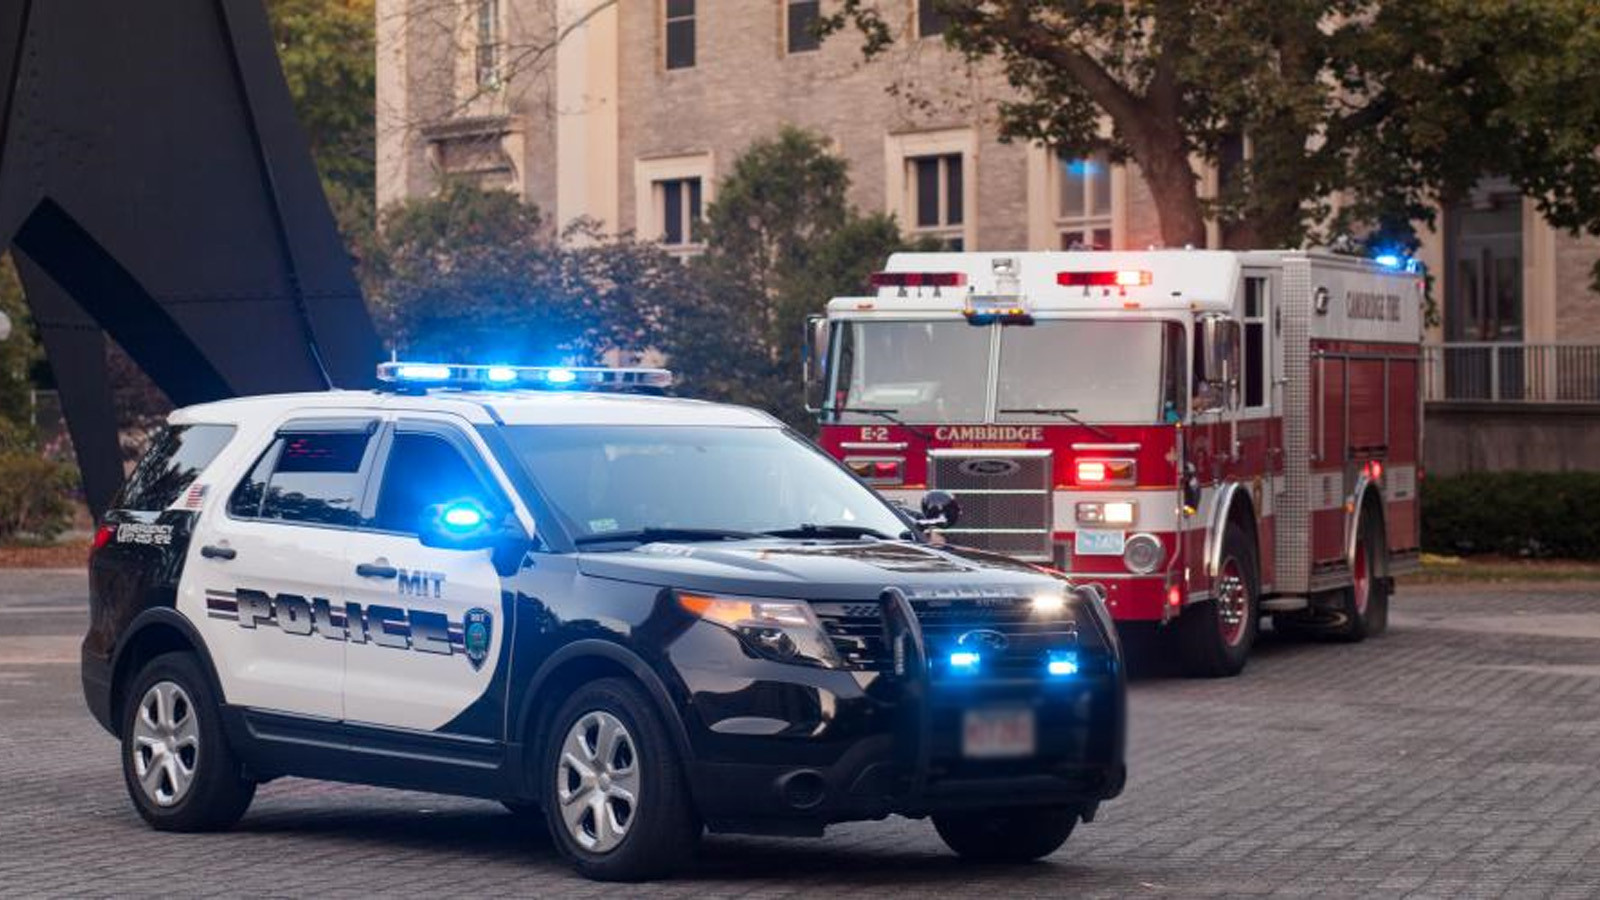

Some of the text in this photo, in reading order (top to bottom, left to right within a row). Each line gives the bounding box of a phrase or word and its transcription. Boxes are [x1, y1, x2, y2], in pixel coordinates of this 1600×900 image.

[934, 425, 1044, 442] CAMBRIDGE
[398, 568, 447, 599] MIT
[236, 588, 453, 656] POLICE
